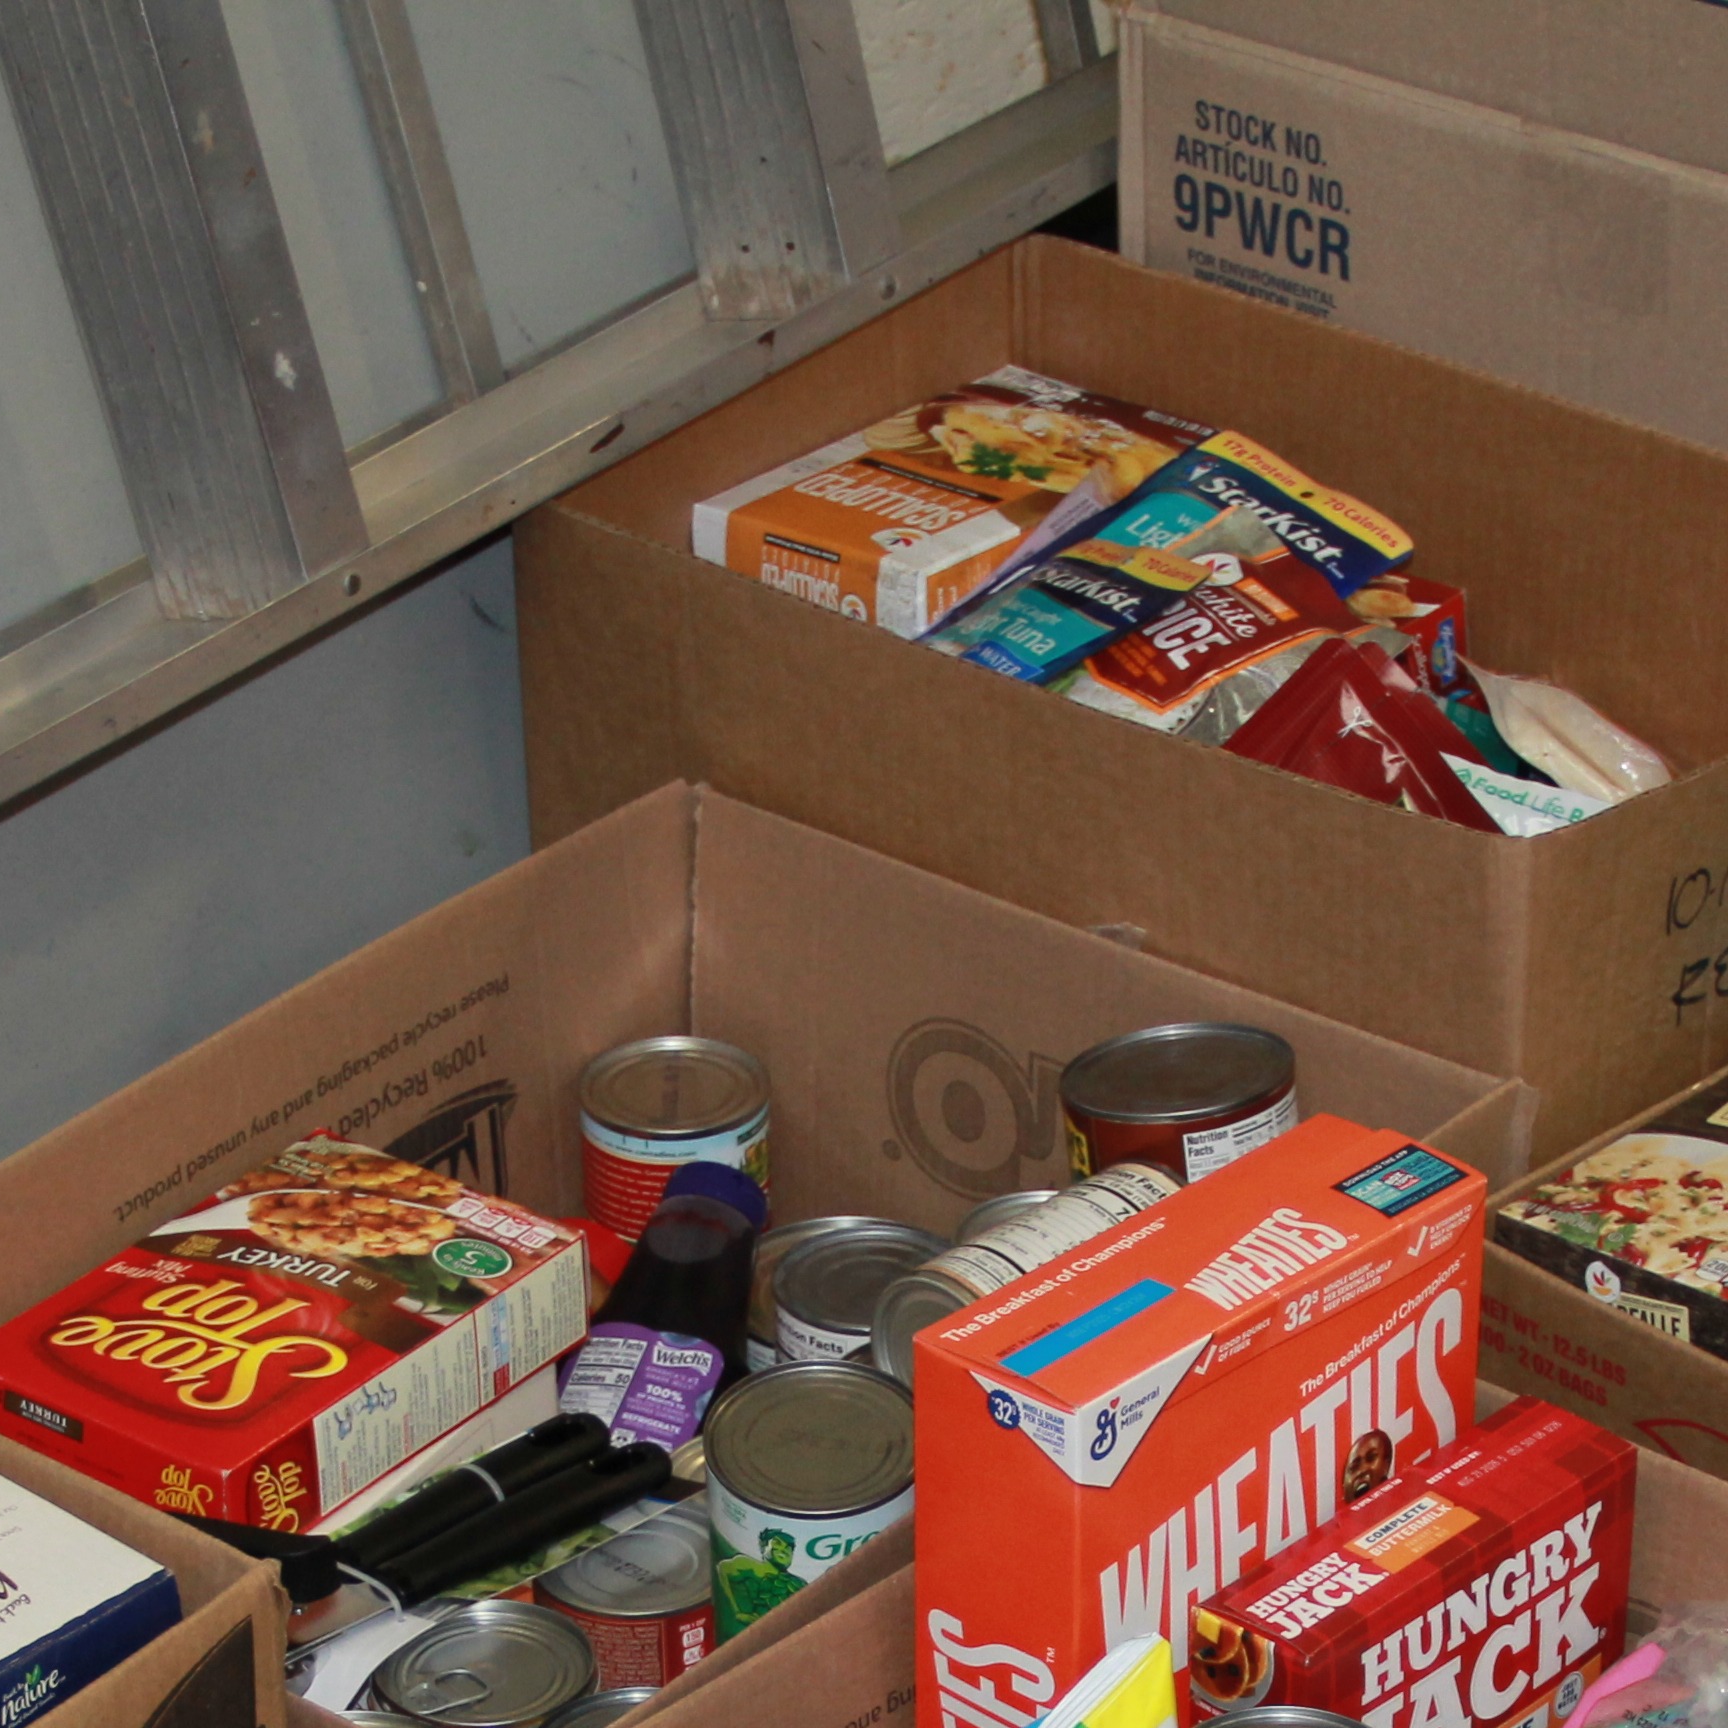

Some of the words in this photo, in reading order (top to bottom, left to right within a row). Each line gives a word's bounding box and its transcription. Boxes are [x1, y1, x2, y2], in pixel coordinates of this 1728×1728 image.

[1195, 100, 1277, 152] STOCK
[1285, 127, 1327, 166] NO.
[1175, 134, 1299, 198] ARTÍCULO
[1308, 174, 1351, 214] NO.
[1174, 173, 1351, 282] 9PWCR
[793, 472, 968, 530] SCALLOPED
[1198, 475, 1343, 562] StarKist
[1247, 451, 1298, 489] Protein
[1324, 496, 1345, 513] 70
[1343, 506, 1399, 549] Calories
[998, 613, 1058, 657] Tuna
[1196, 586, 1258, 638] white
[1472, 775, 1528, 806] Food
[459, 971, 511, 1011] Please
[401, 1004, 457, 1047] recycle
[315, 1032, 400, 1097] packaging
[431, 1033, 488, 1083] 100%
[250, 1108, 281, 1143] any
[281, 1091, 313, 1124] and
[338, 1072, 429, 1138] Recycled
[185, 1131, 248, 1174] unused
[1186, 1130, 1229, 1147] Nutrition
[1187, 1144, 1215, 1159] Facts
[113, 1165, 183, 1224] product.
[216, 1244, 354, 1289] TURKEY
[1183, 1206, 1348, 1312] WHEATIES
[142, 1277, 309, 1350] Top
[939, 1322, 972, 1343] The
[973, 1273, 1058, 1328] Breakfast
[1057, 1265, 1073, 1284] of
[51, 1315, 349, 1412] Stove
[655, 1349, 712, 1368] Welch's
[1299, 1373, 1324, 1398] The
[1325, 1325, 1384, 1380] Breakfast
[1385, 1313, 1398, 1333] of
[645, 1383, 685, 1403] 100%
[1120, 1386, 1160, 1417] General
[1559, 1367, 1610, 1407] BAGS
[19, 1400, 68, 1430] TURKEY
[1120, 1409, 1144, 1431] Mills
[1364, 1501, 1427, 1545] COMPLETE
[1368, 1503, 1452, 1559] BUTTERMILK
[1246, 1551, 1349, 1620] HUNGRY
[1360, 1500, 1603, 1707] HUNGRY
[0, 1667, 61, 1727] nature
